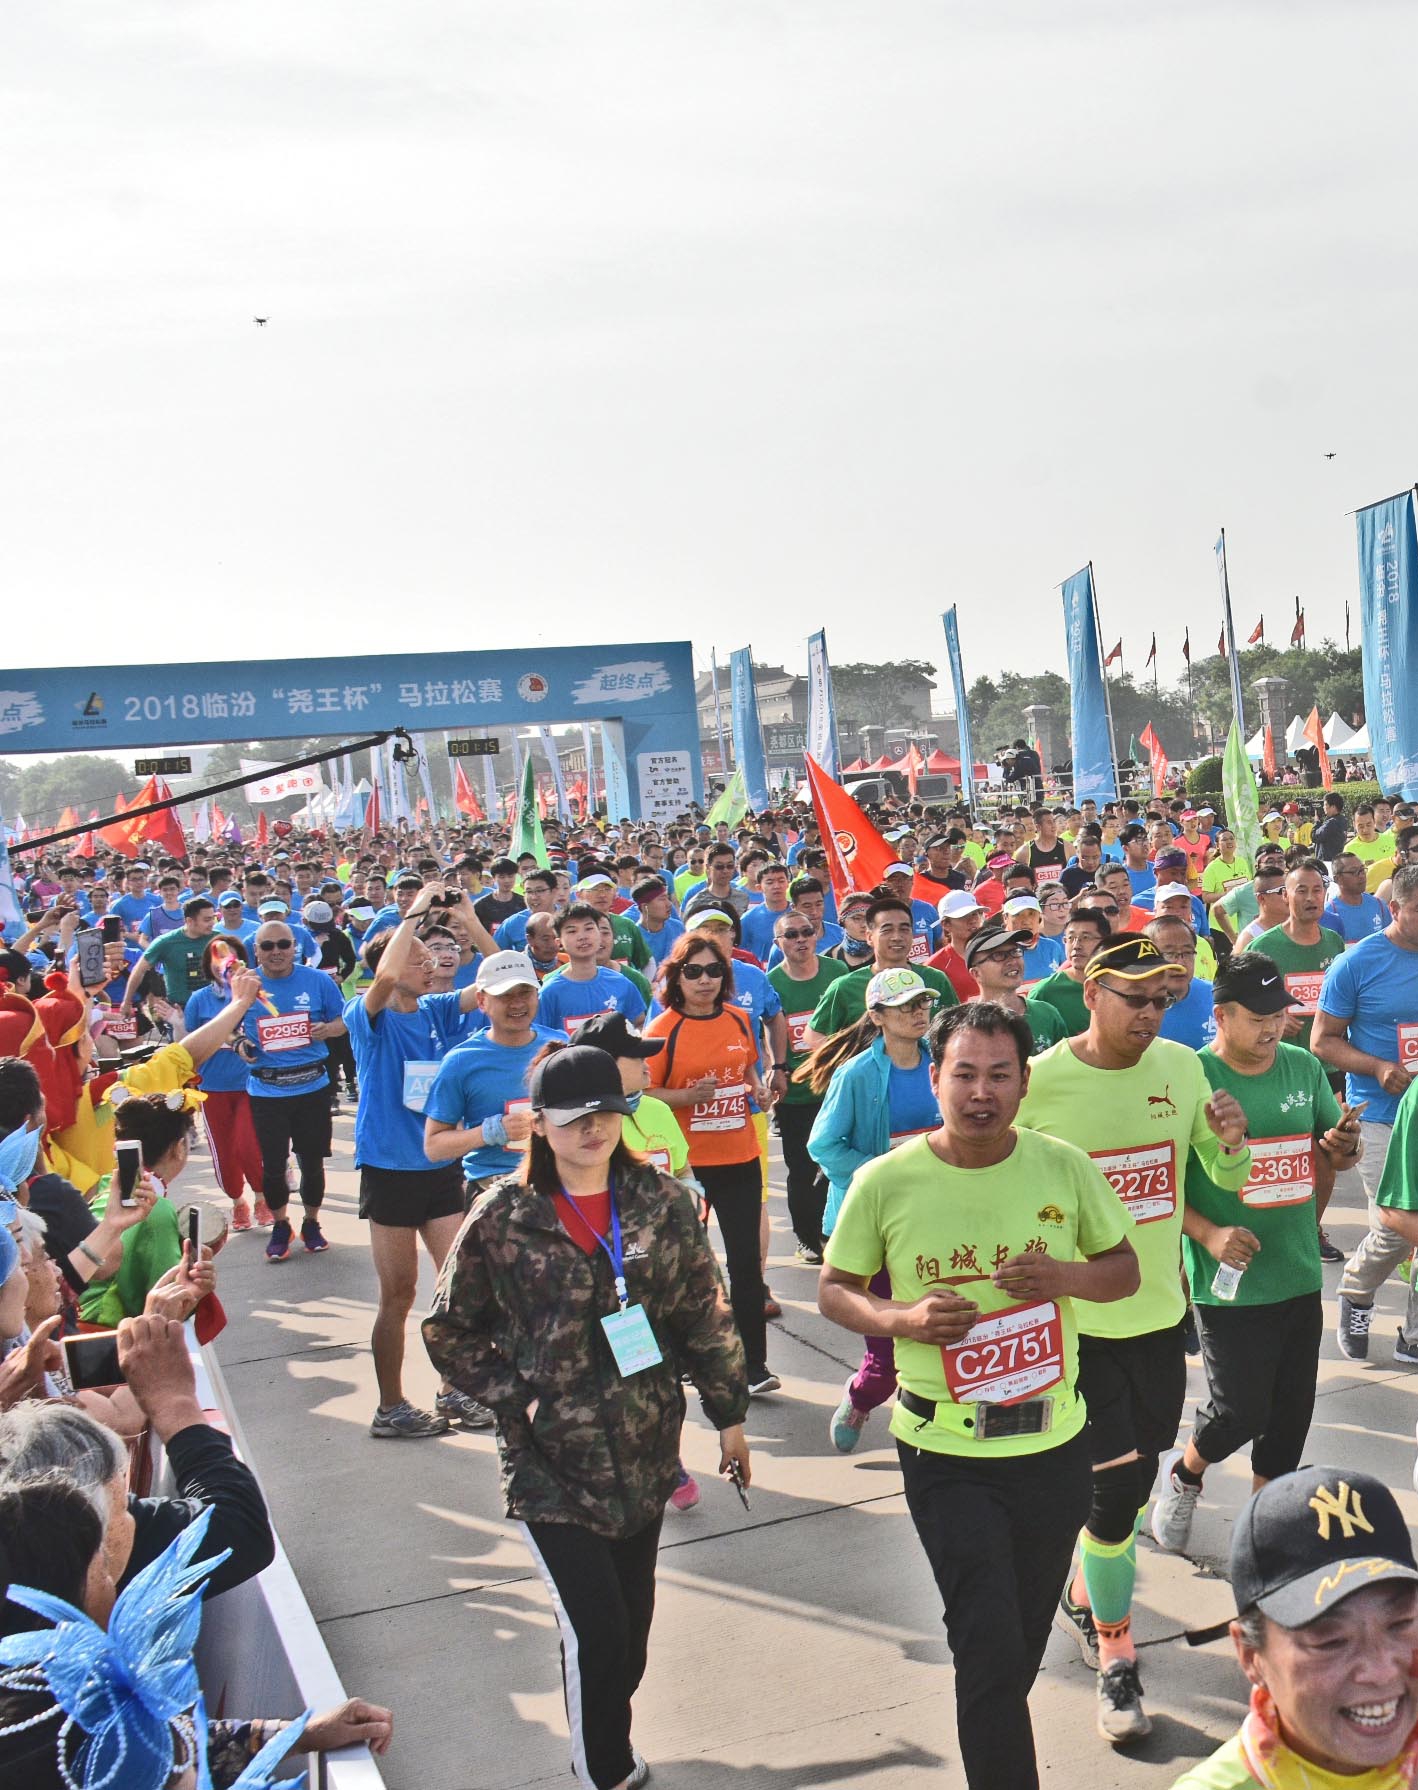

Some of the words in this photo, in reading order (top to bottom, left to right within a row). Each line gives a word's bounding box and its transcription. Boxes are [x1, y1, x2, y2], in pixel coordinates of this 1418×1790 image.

[600, 672, 654, 691] 起终点
[262, 1022, 307, 1039] C2956
[694, 1096, 745, 1118] D4745
[1107, 1166, 1169, 1199] 2273
[1249, 1154, 1309, 1183] C3618
[955, 1326, 1052, 1380] C2751
[1308, 1480, 1376, 1541] NY
